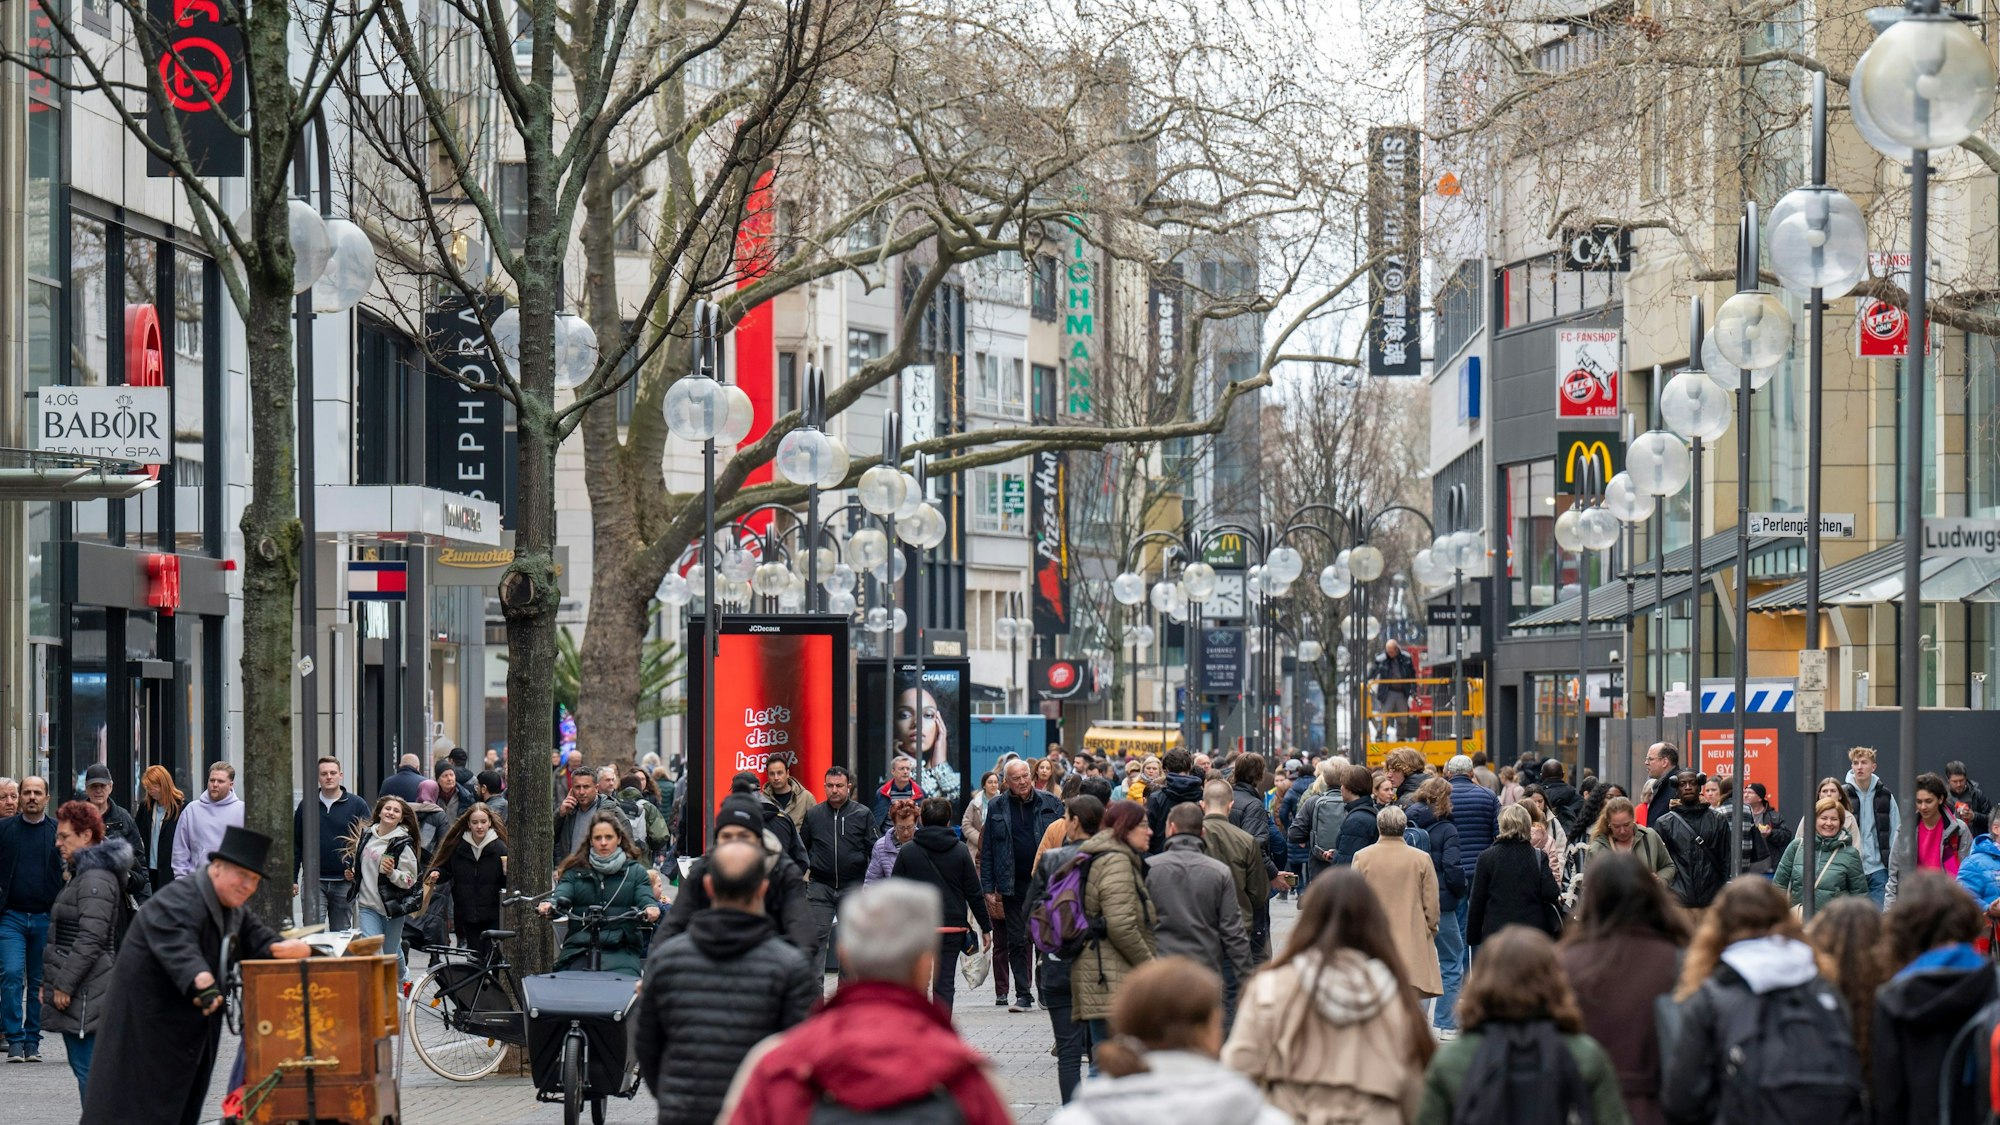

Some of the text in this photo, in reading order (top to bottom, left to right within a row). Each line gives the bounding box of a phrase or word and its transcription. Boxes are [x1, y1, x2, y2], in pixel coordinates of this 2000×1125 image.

[1571, 234, 1622, 264] C&A
[1065, 185, 1093, 414] ICHMANN
[1560, 332, 1617, 343] FC-FANSHOP
[44, 393, 79, 406] 4.OG
[1595, 406, 1617, 416] ETAGE
[45, 411, 161, 440] BABOR
[126, 446, 161, 457] SPA
[1037, 498, 1061, 563] Pizza
[1763, 517, 1842, 535] Perlengächen
[749, 625, 781, 633] JCDecaux
[922, 674, 956, 682] CHANEL
[745, 705, 791, 726] Let's
[746, 728, 789, 748] date
[1708, 750, 1725, 758] NEU
[1743, 748, 1758, 758] ÖLN
